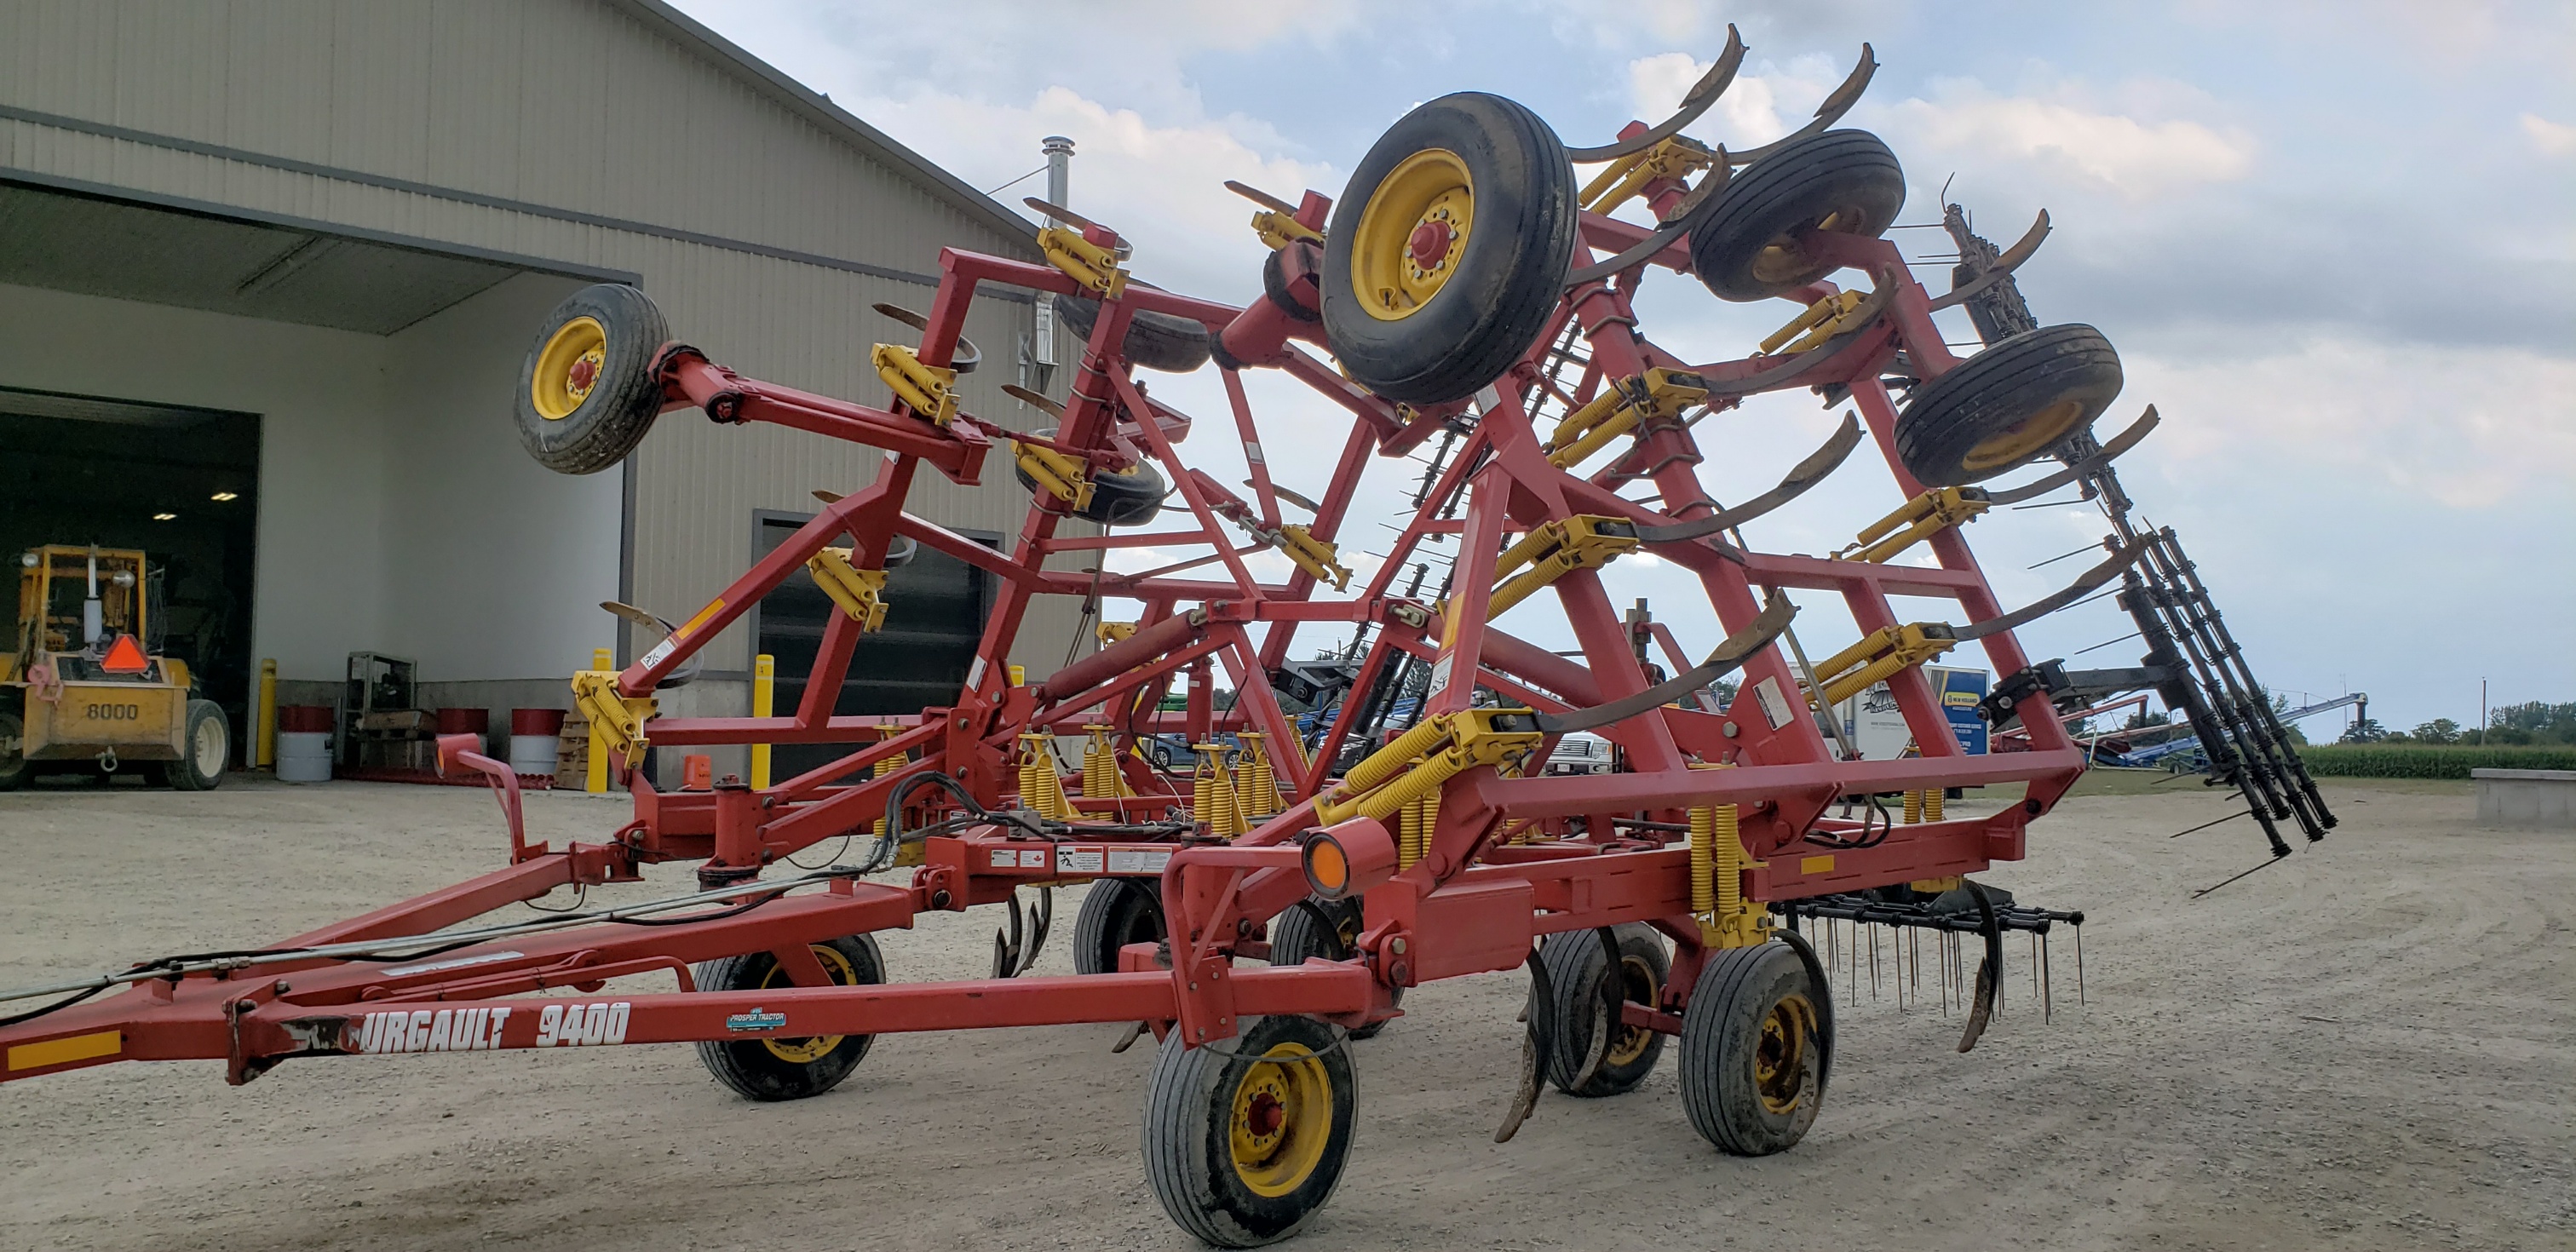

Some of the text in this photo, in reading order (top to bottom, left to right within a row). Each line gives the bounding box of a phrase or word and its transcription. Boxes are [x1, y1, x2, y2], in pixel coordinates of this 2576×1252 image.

[87, 703, 138, 721] 8000
[730, 1013, 785, 1022] PROSPER TRACTOR
[343, 1002, 630, 1054] URGAULT 9400
